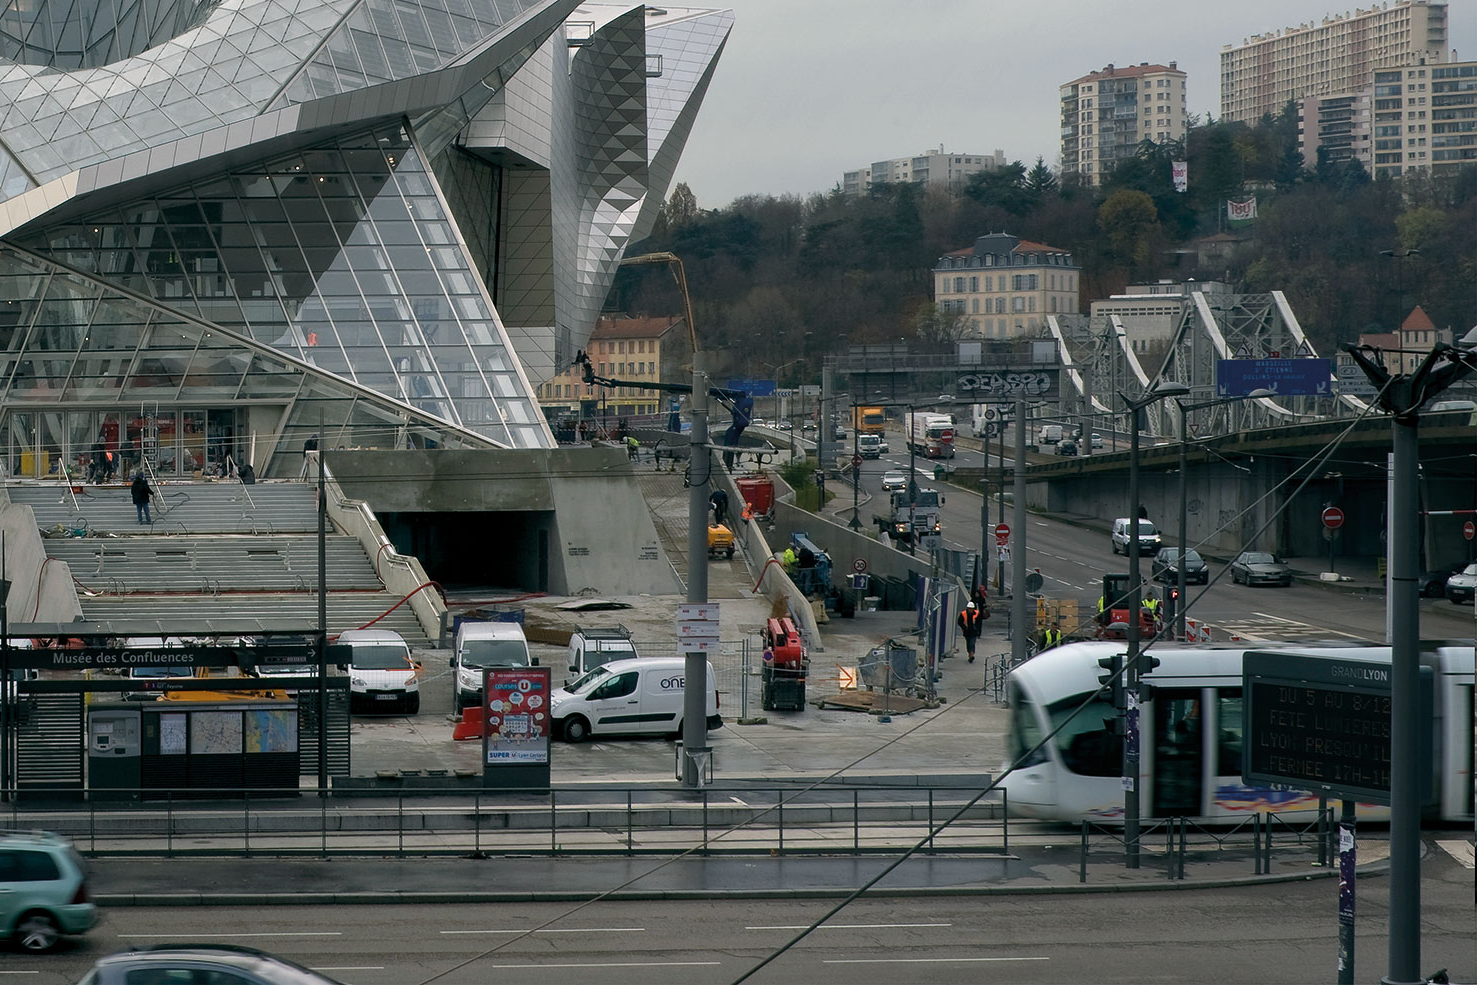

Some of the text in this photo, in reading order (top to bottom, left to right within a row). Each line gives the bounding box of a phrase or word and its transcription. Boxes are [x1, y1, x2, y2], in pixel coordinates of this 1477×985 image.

[53, 651, 194, 664] Musée des Confluences
[660, 678, 684, 689] ONE
[1331, 666, 1388, 682] GRANDLYON
[1279, 687, 1391, 714] DU 5 AU 8/12
[1269, 710, 1391, 738] FETE LUMIERES
[1306, 737, 1391, 762] PRESQU'IL
[1269, 755, 1324, 777] FERMEE
